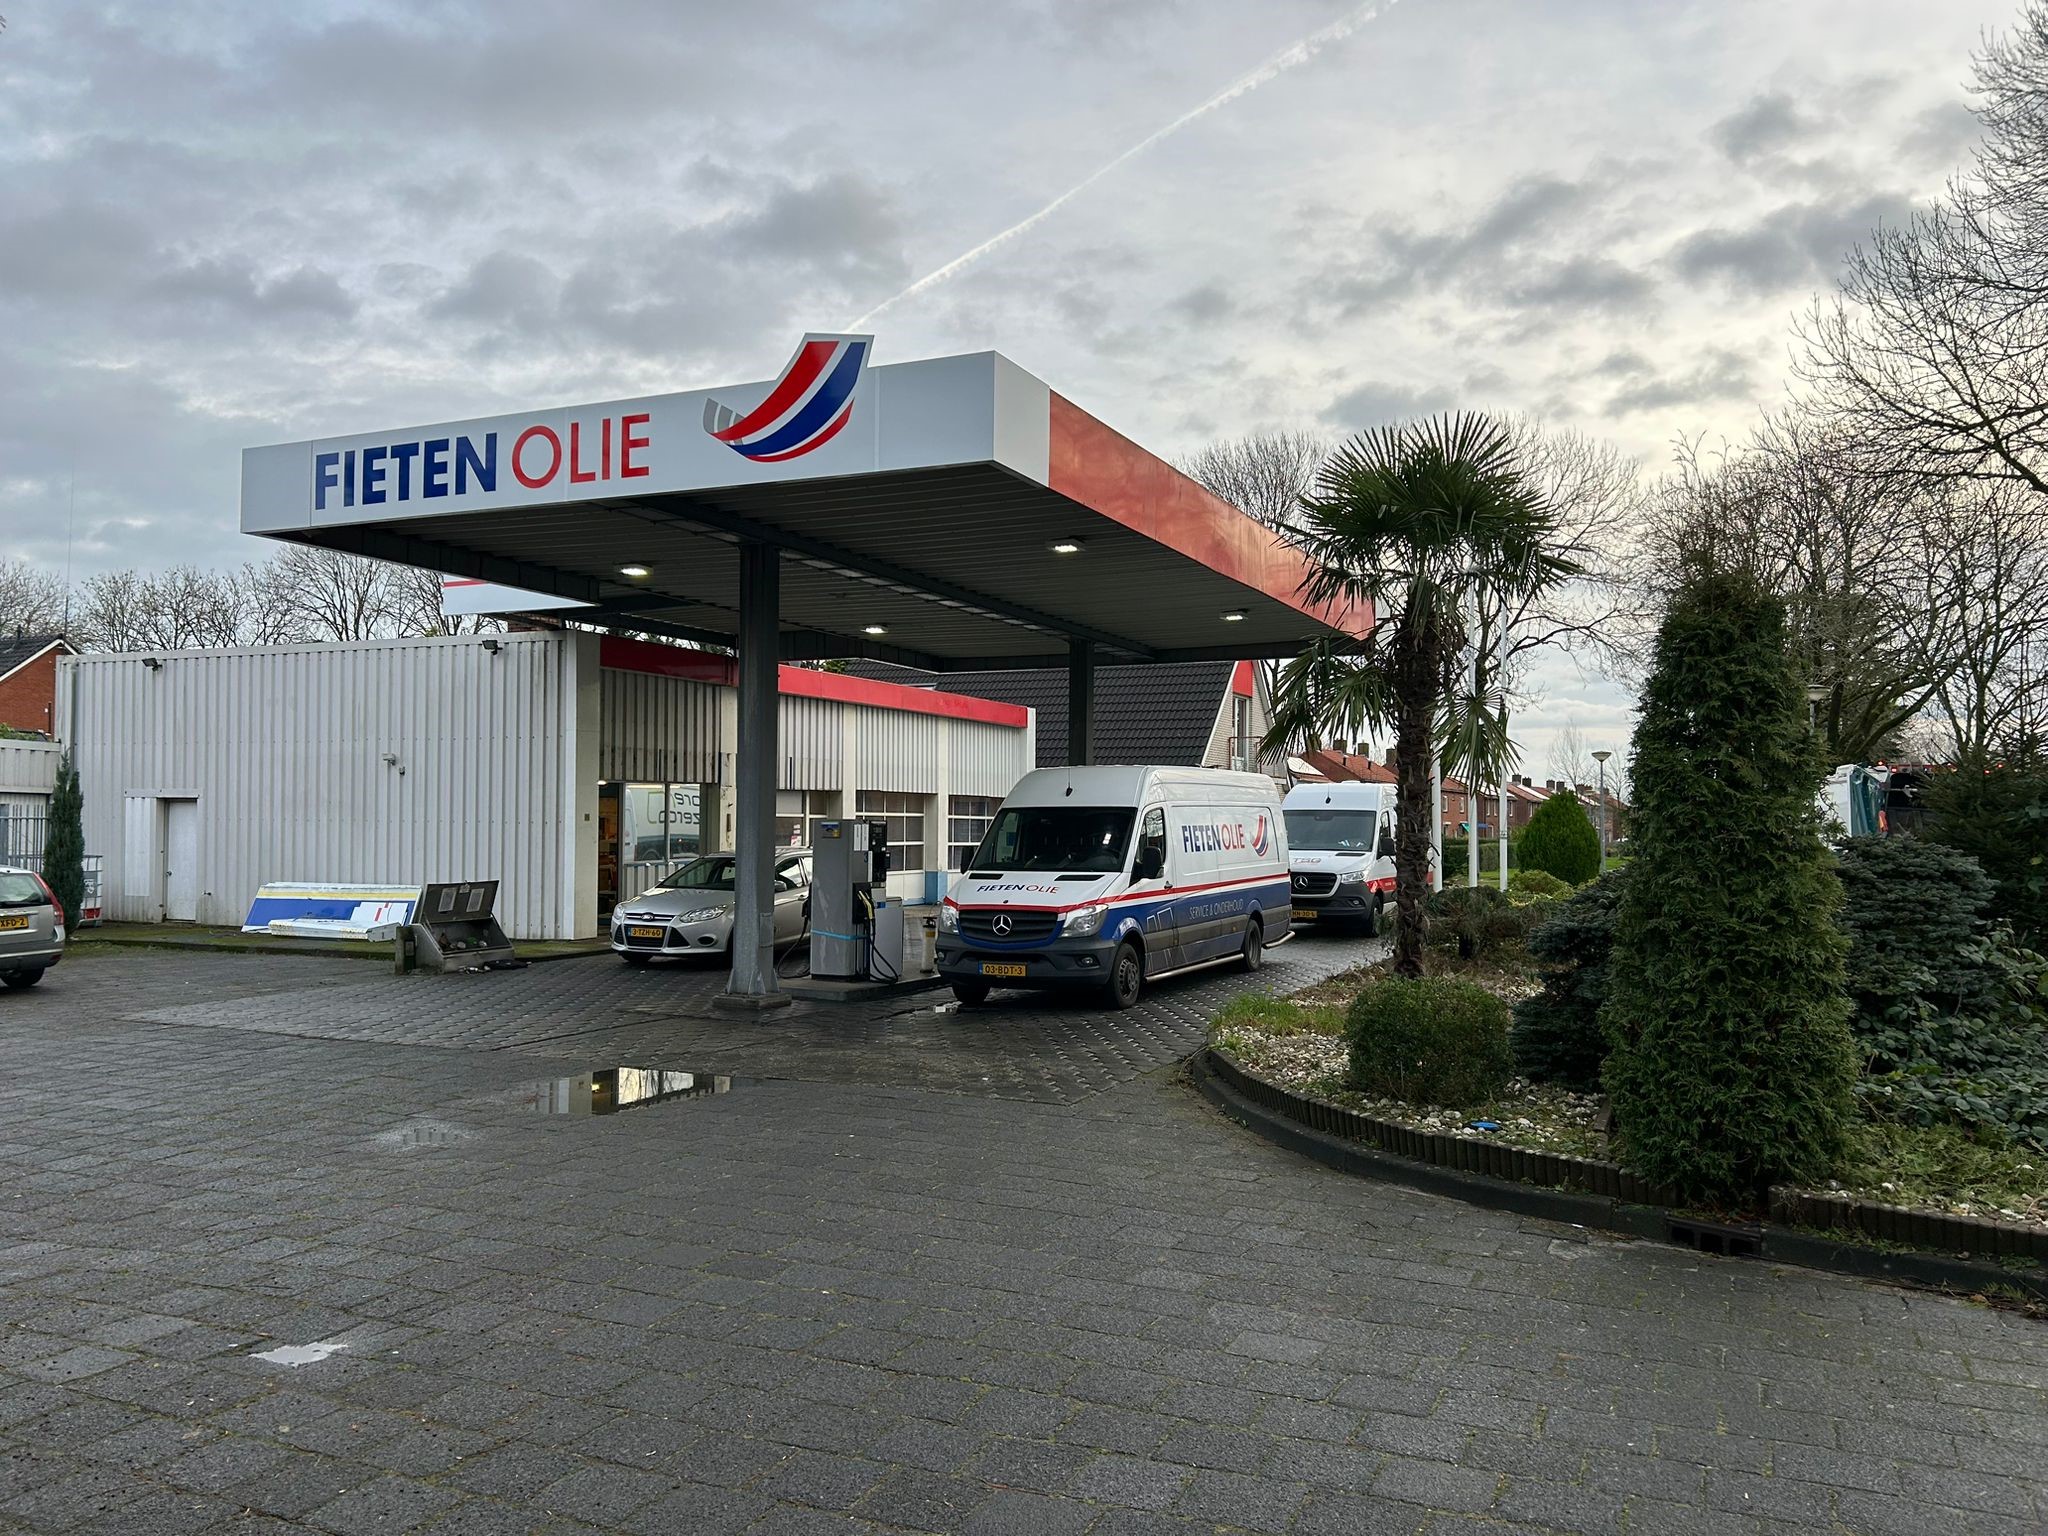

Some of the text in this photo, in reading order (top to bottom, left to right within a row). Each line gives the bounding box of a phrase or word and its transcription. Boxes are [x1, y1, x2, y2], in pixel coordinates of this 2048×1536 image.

[315, 413, 650, 510] FIETEN OLIE
[1181, 823, 1246, 853] FIETEN OLIE
[977, 884, 1059, 894] FIETEN OLIE
[985, 964, 1023, 975] 03-BDT-3
